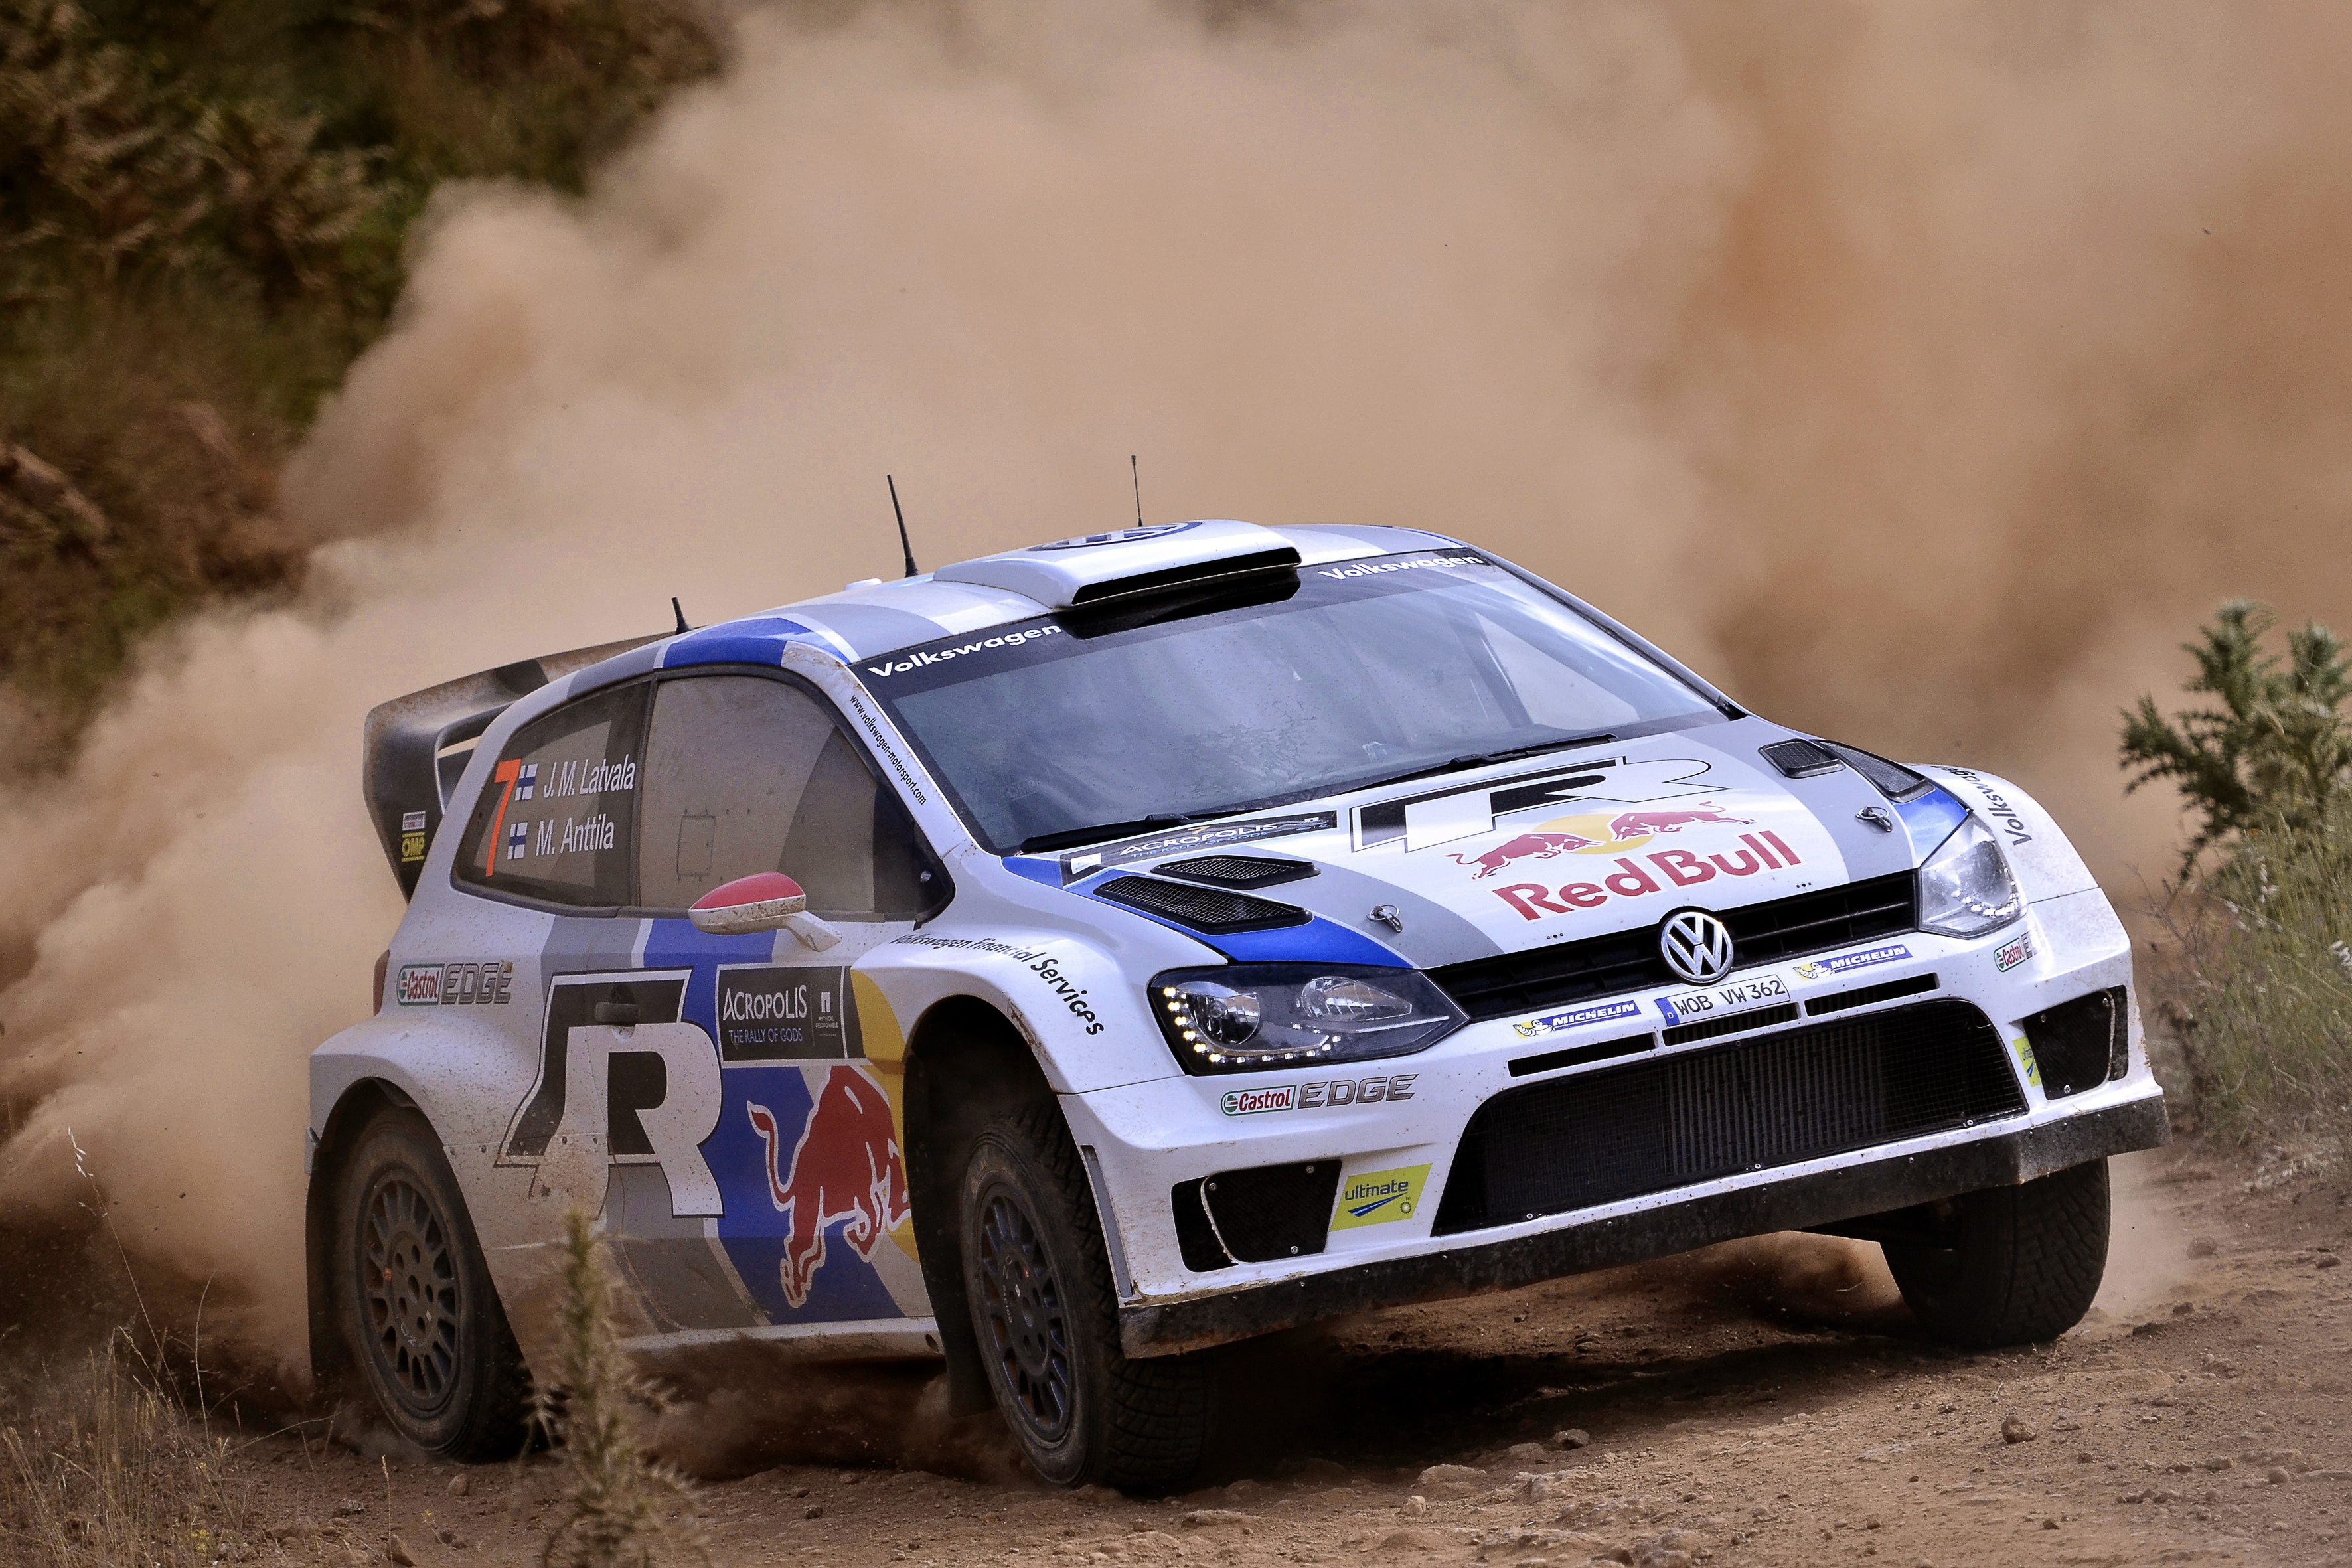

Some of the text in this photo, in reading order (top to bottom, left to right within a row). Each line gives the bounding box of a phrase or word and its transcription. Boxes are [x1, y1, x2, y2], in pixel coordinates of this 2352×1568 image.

[1318, 554, 1484, 580] Volkswagen
[868, 625, 1062, 677] Volkswagen
[850, 694, 927, 805] www.volkswagen-motorsport.com
[544, 754, 635, 797] J. M. Latvala
[485, 759, 521, 877] 7
[536, 813, 614, 856] M. Anttila
[402, 837, 424, 857] OMP
[1120, 823, 1277, 856] ACROPOLIS
[1492, 830, 1802, 921] Red Bull
[1830, 947, 1907, 969] MICHELIN
[407, 963, 514, 1004] Castrol EDGE
[967, 937, 1047, 962] Financial
[1030, 958, 1105, 1036] Services
[1673, 995, 1713, 1016] WOB
[1719, 986, 1747, 1005] VW
[1746, 980, 1786, 1000] 362
[723, 984, 808, 1021] ACROPOLIS
[1552, 1003, 1635, 1026] MICHELIN
[728, 1028, 803, 1044] THE RALLY OF GODS
[1239, 1074, 1419, 1112] Castrol EDGE
[1344, 1179, 1409, 1201] ultimate
